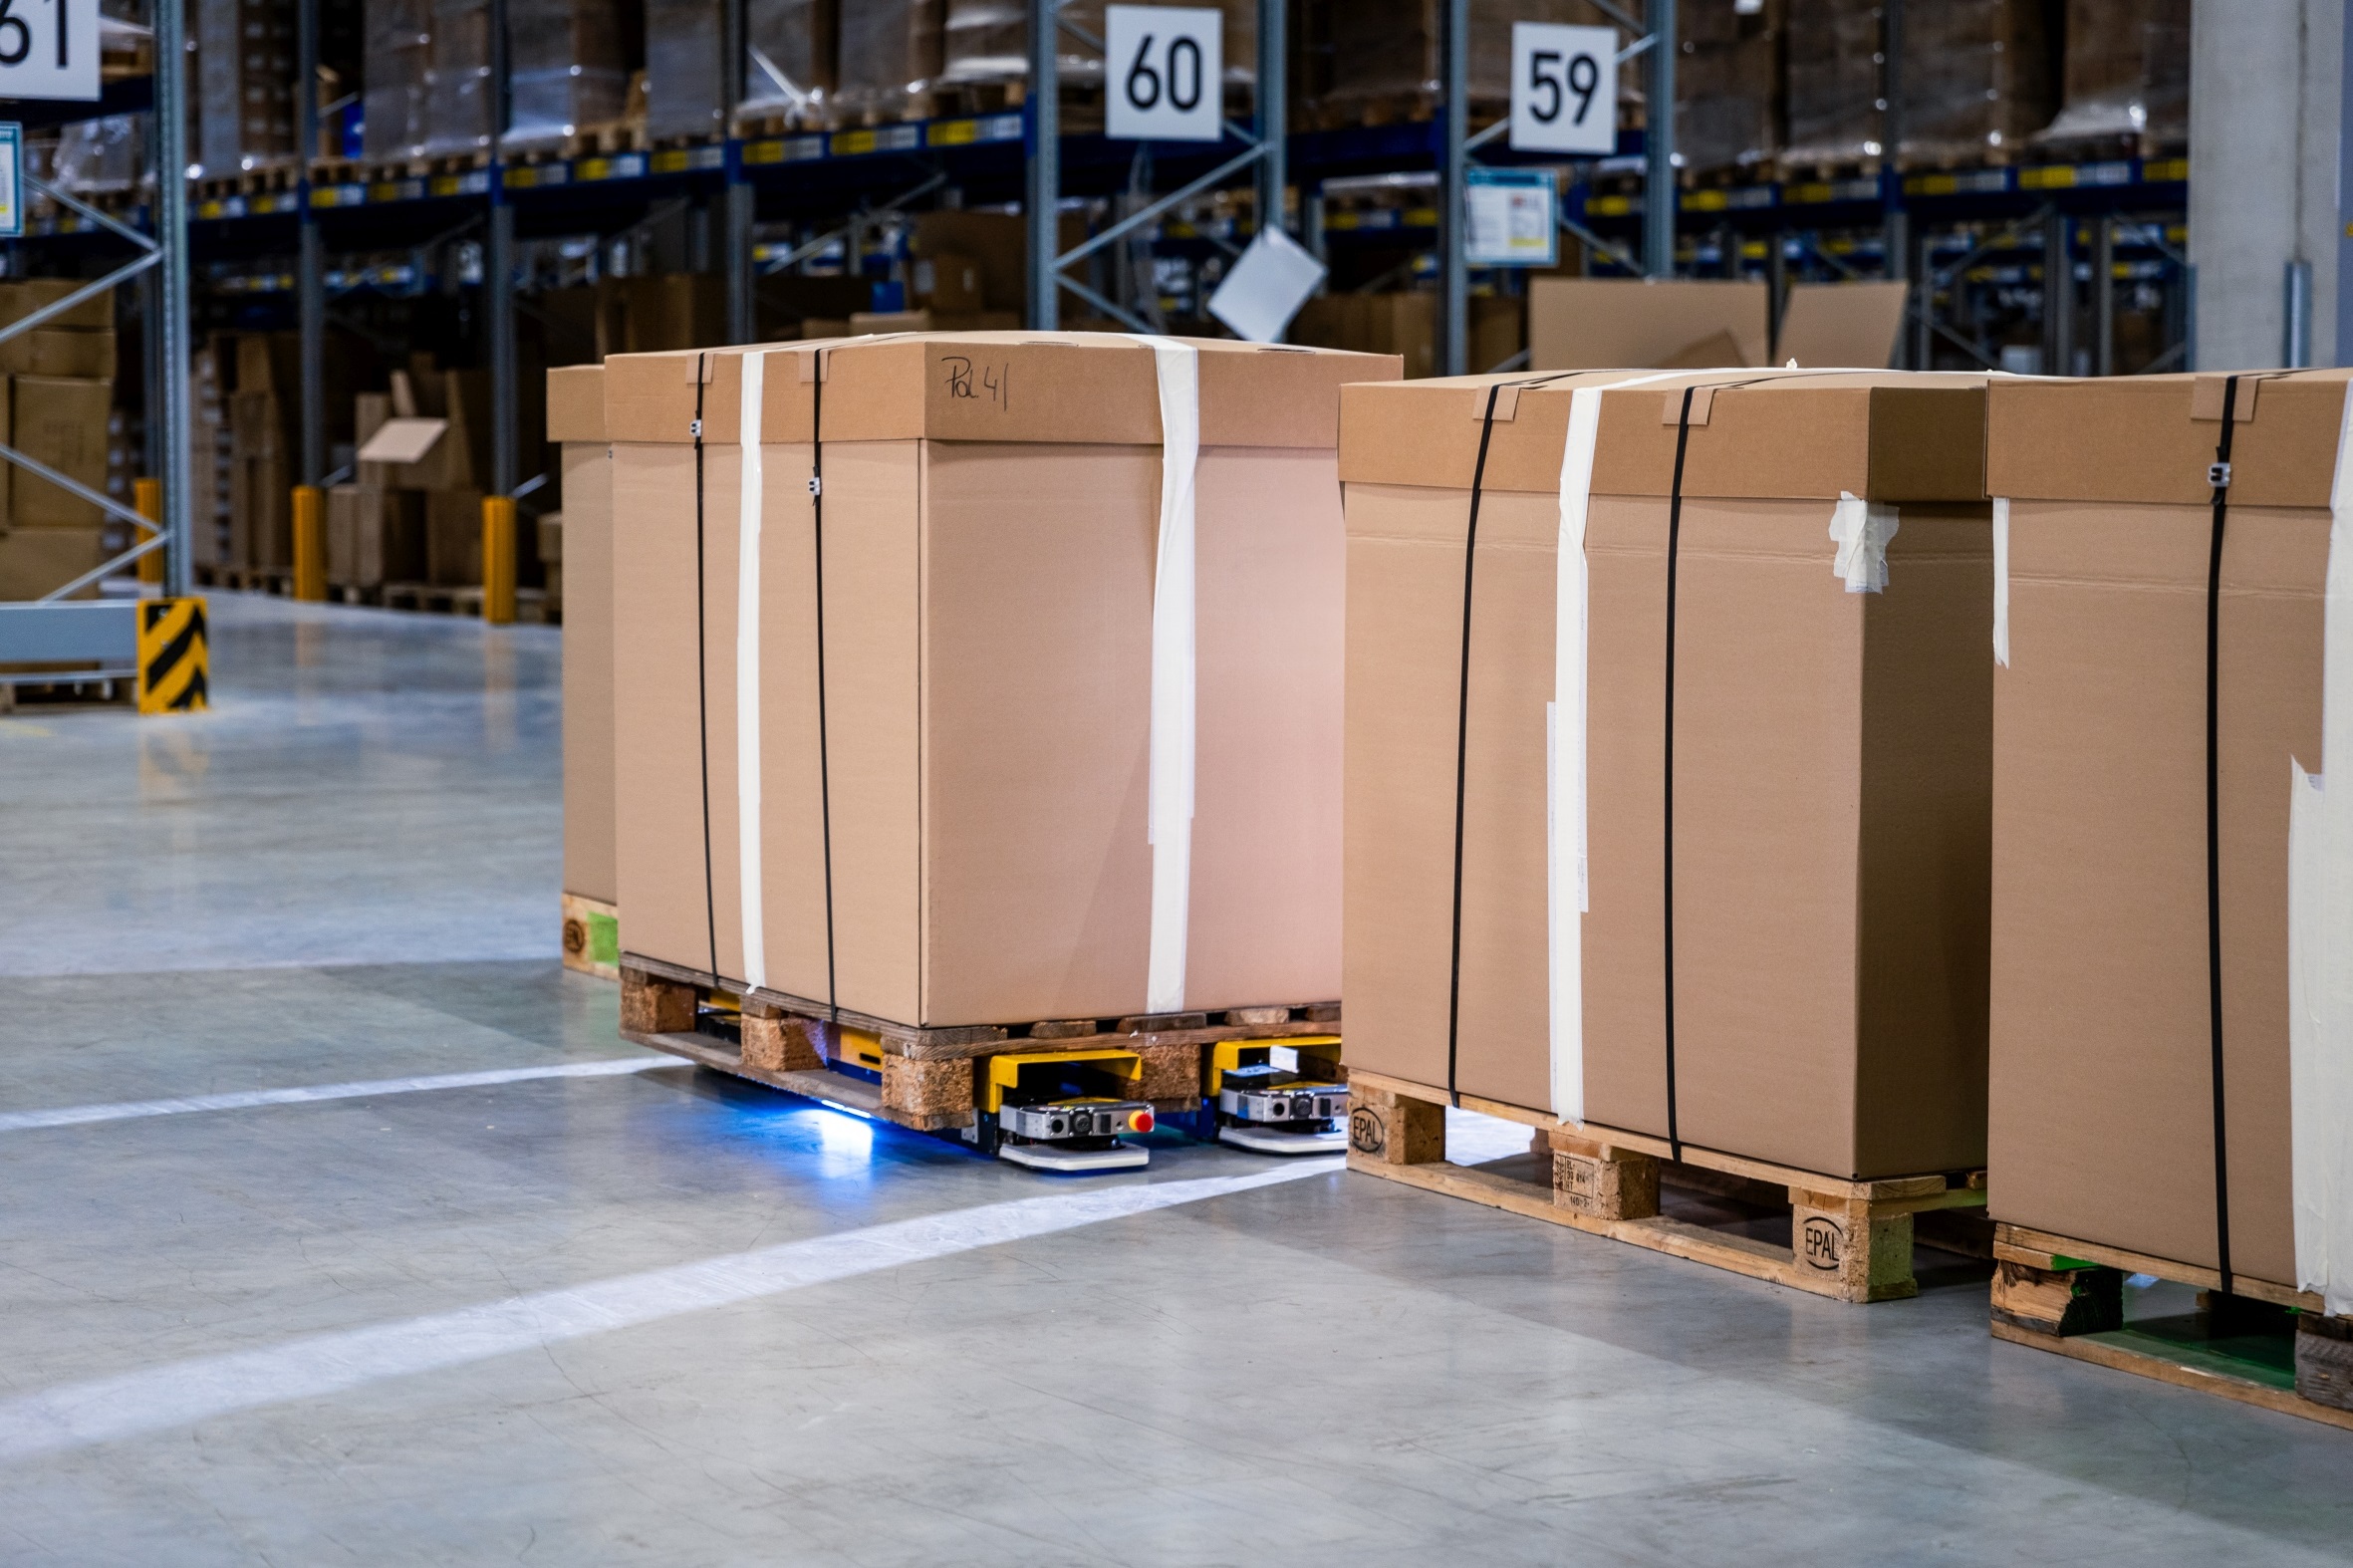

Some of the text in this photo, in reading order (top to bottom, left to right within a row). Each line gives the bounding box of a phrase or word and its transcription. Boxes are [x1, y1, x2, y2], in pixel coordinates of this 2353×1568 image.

[0, 0, 69, 70] 61
[1126, 34, 1202, 112] 60
[1528, 50, 1599, 126] 59
[1353, 1116, 1379, 1146] EPAL
[1805, 1226, 1840, 1262] EPAL
